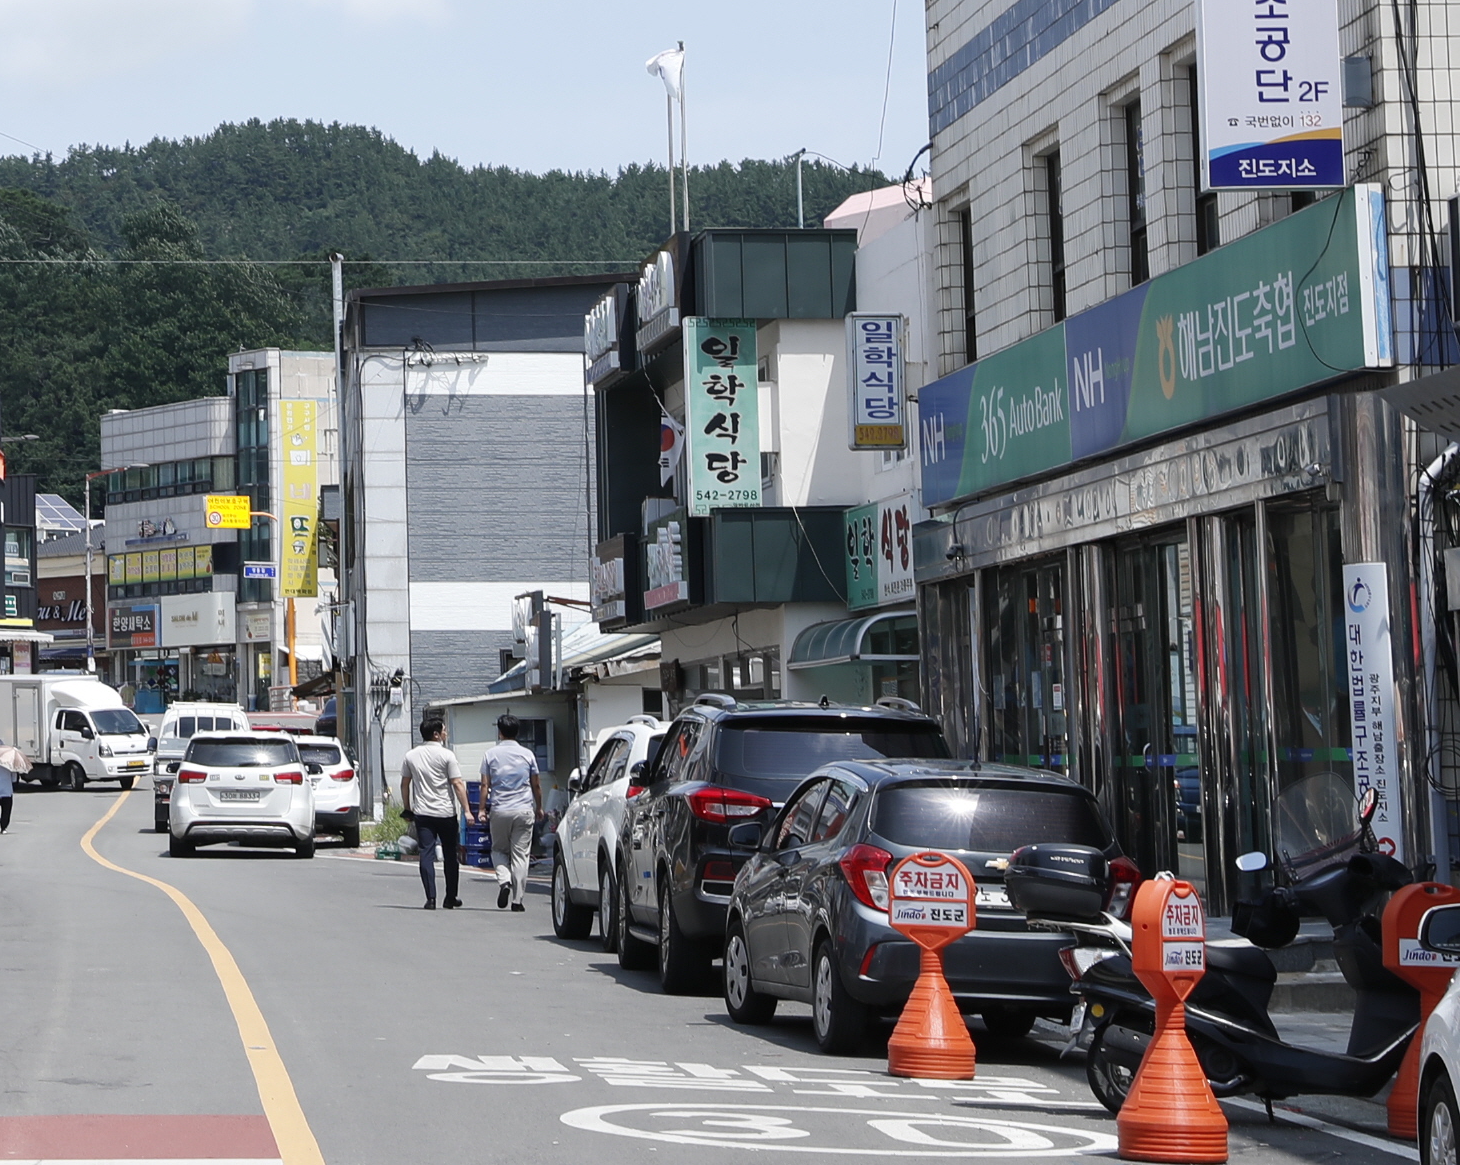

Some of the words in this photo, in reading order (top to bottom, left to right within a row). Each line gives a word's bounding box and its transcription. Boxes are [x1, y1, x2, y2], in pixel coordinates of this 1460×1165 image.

[1298, 81, 1330, 103] 2F
[1244, 114, 1295, 129] 국번없이
[1299, 114, 1323, 128] 132
[1238, 157, 1318, 179] 진도지소
[1176, 269, 1297, 382] 해남진도축협
[1302, 270, 1350, 328] 진도지점
[860, 320, 899, 420] 일학식당
[1072, 346, 1105, 412] NH
[700, 335, 748, 484] 일학식당
[979, 385, 1007, 465] 365
[922, 411, 946, 467] NH
[696, 489, 758, 501] 542-2798
[112, 615, 152, 633] 한양세탁소
[1348, 623, 1372, 803] 대한법률구조공
[1368, 673, 1383, 717] 광주지부
[1371, 720, 1385, 775] 해남출장소
[899, 870, 960, 891] 주차금지
[930, 907, 965, 922] 진도군
[1166, 903, 1200, 927] 주차금지
[1185, 949, 1203, 966] 진도군
[648, 1111, 1056, 1151] 30
